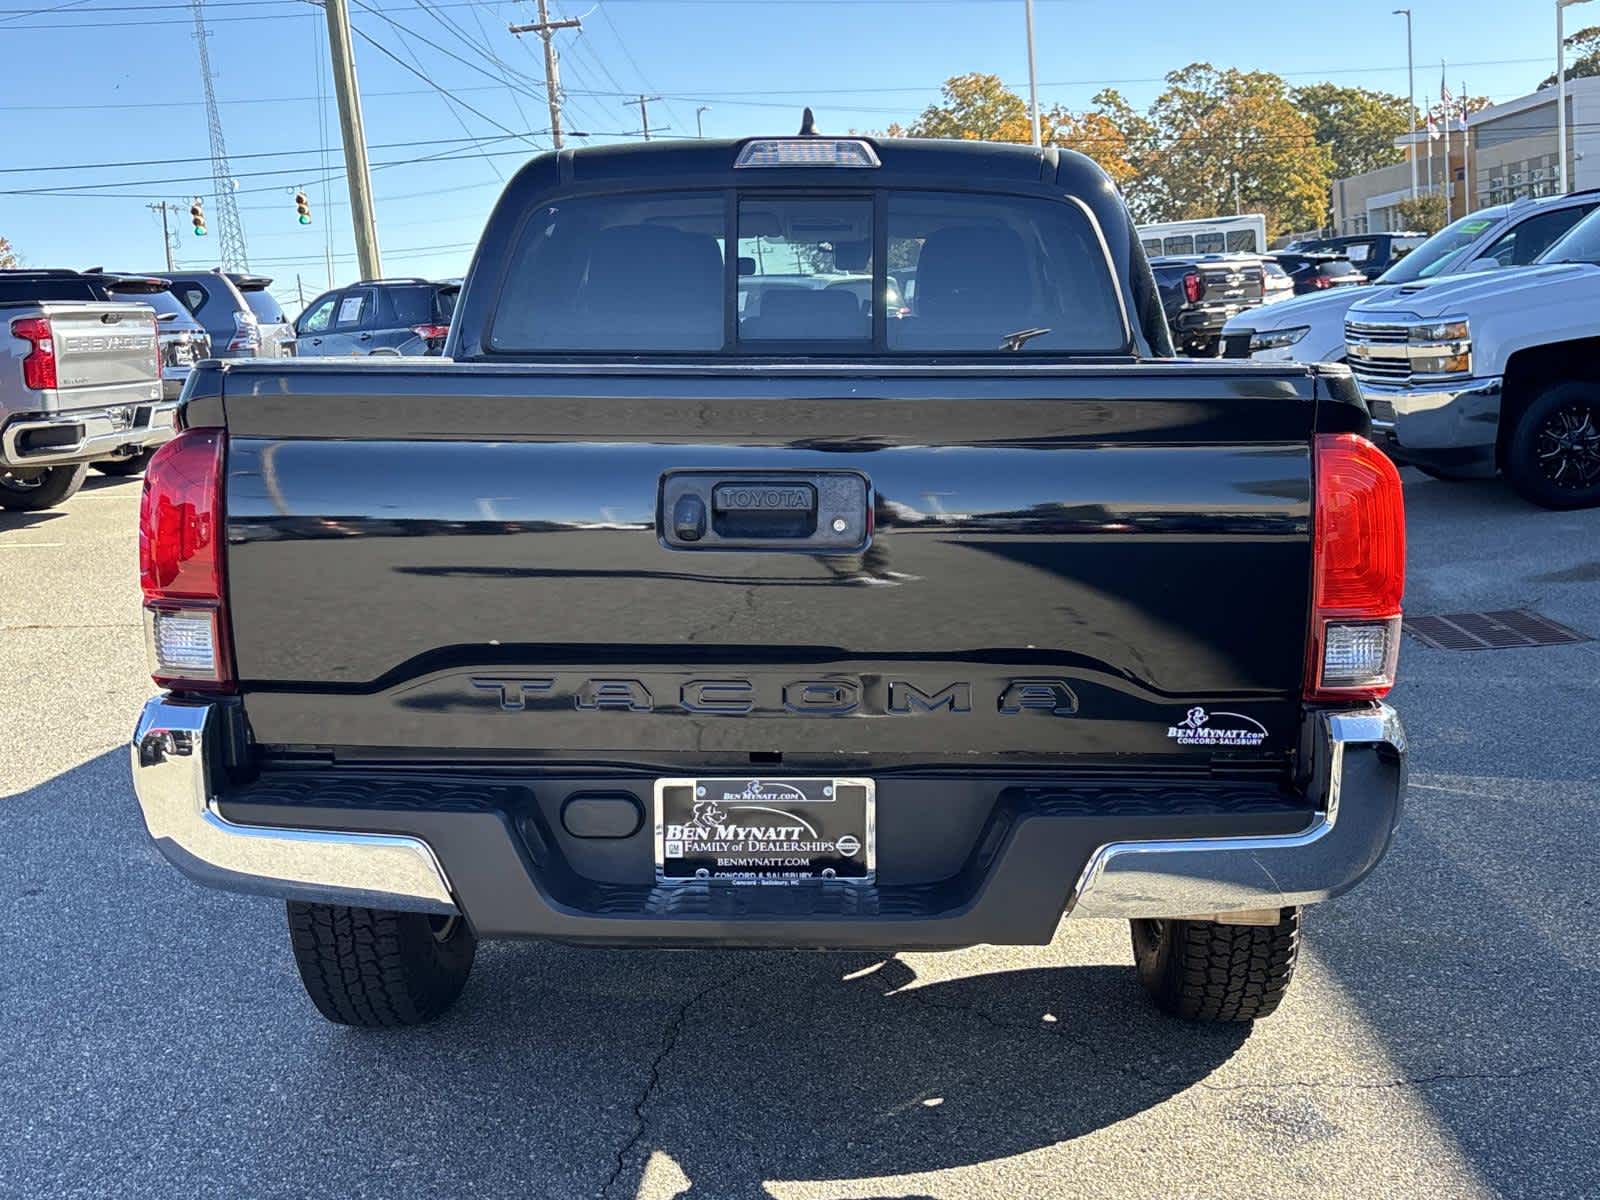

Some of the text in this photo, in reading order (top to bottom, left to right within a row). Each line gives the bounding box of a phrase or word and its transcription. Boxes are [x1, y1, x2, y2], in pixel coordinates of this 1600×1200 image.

[722, 489, 809, 507] TOYOTA
[471, 675, 1080, 715] TACOMA
[665, 825, 804, 840] BEN MYNATT
[684, 841, 730, 852] FAMILY
[731, 842, 743, 852] of
[748, 841, 834, 852] DEALERSHIPS
[717, 858, 810, 866] BENMYNATT.COM
